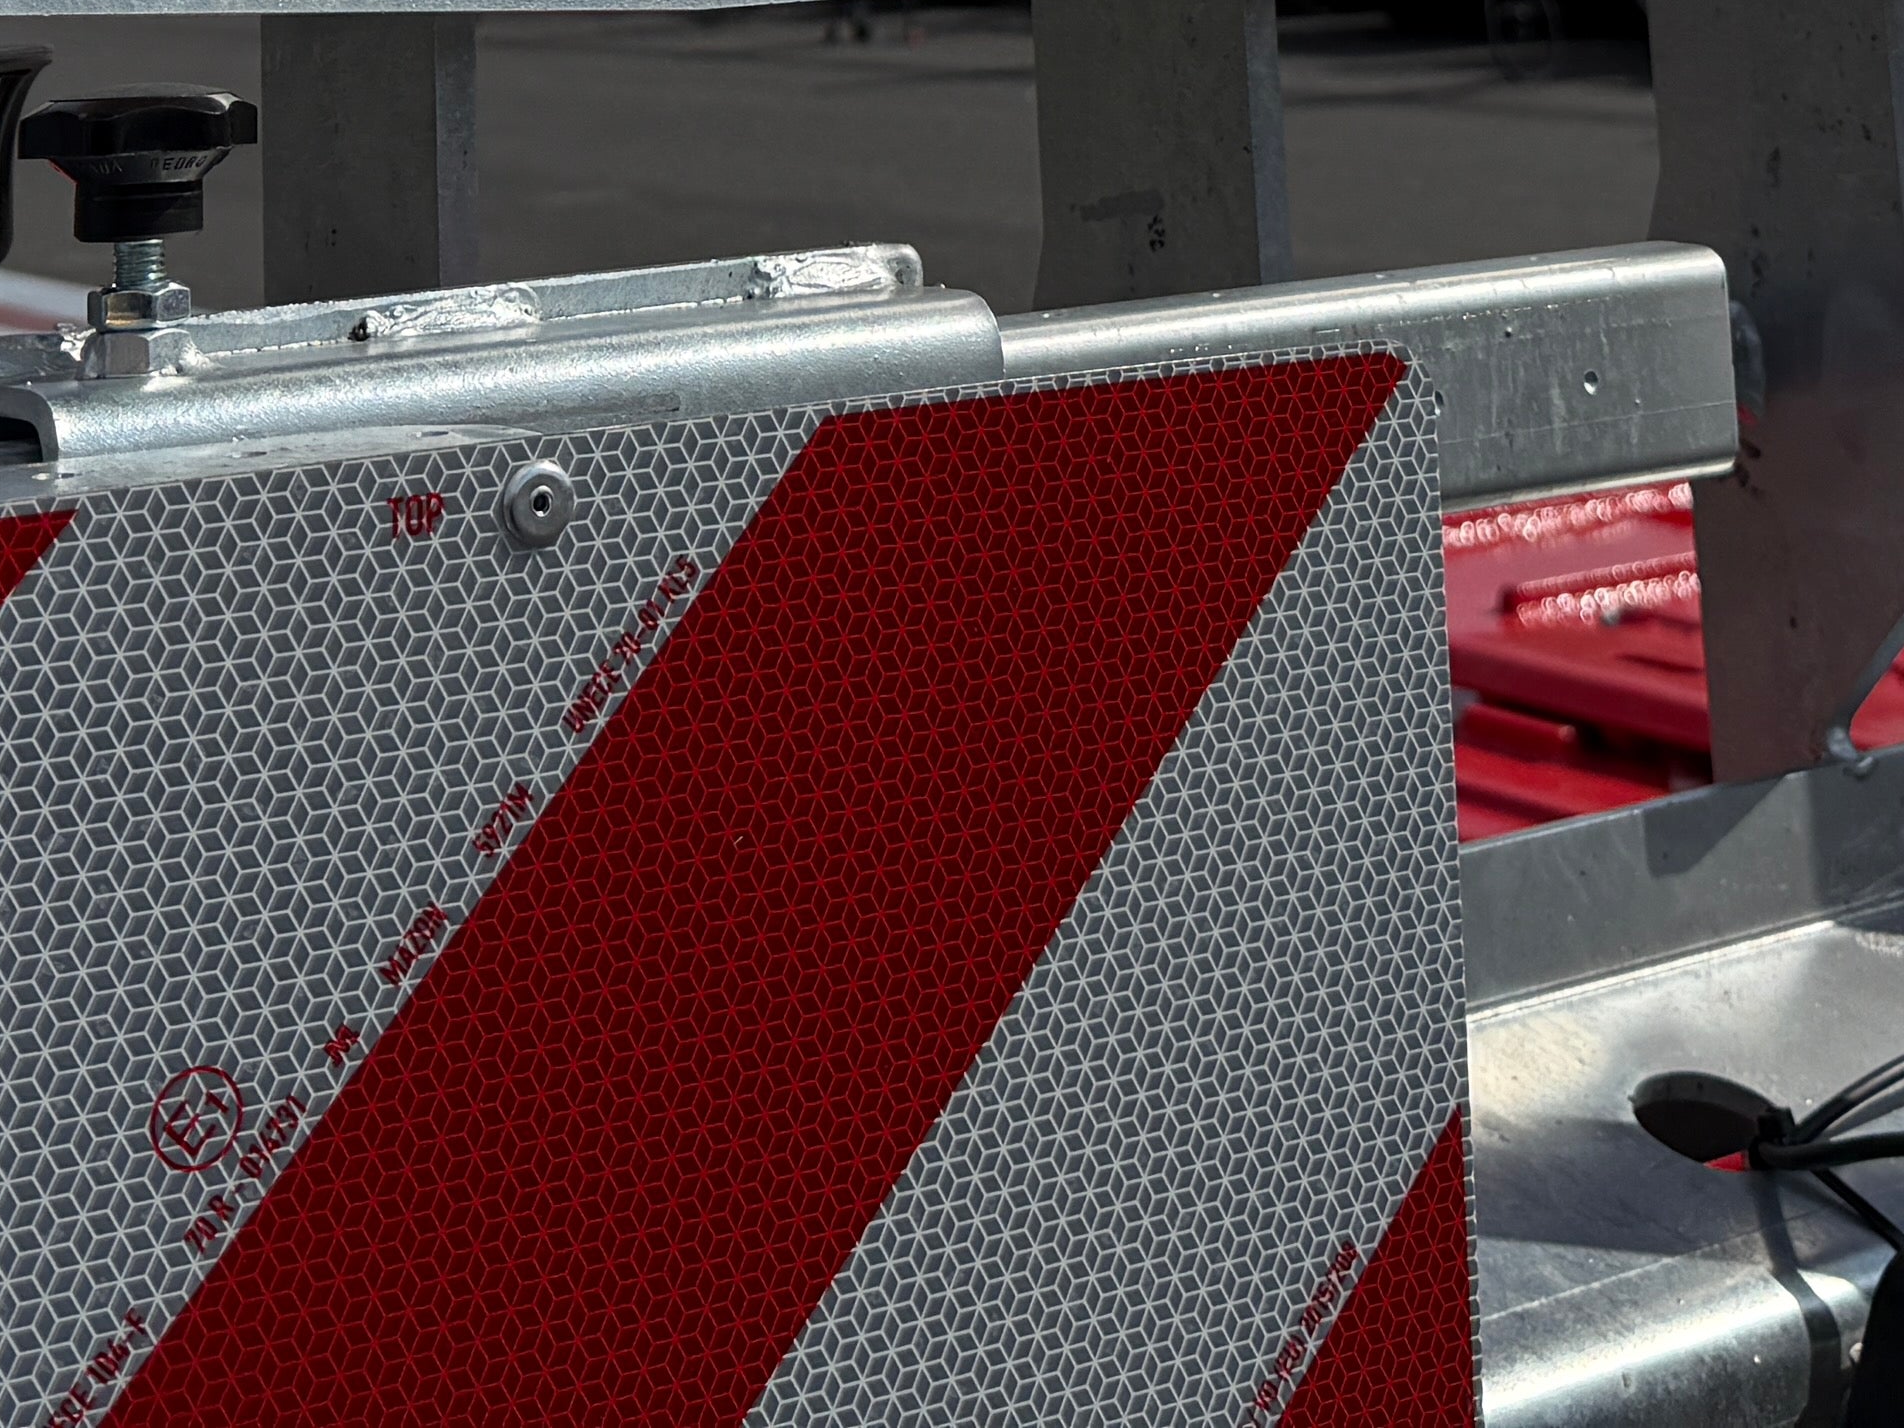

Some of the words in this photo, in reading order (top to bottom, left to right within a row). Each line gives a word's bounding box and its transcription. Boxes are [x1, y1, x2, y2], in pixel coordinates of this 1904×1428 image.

[386, 491, 444, 541] TOP
[562, 660, 622, 734] UNECE
[183, 1215, 219, 1255] 70
